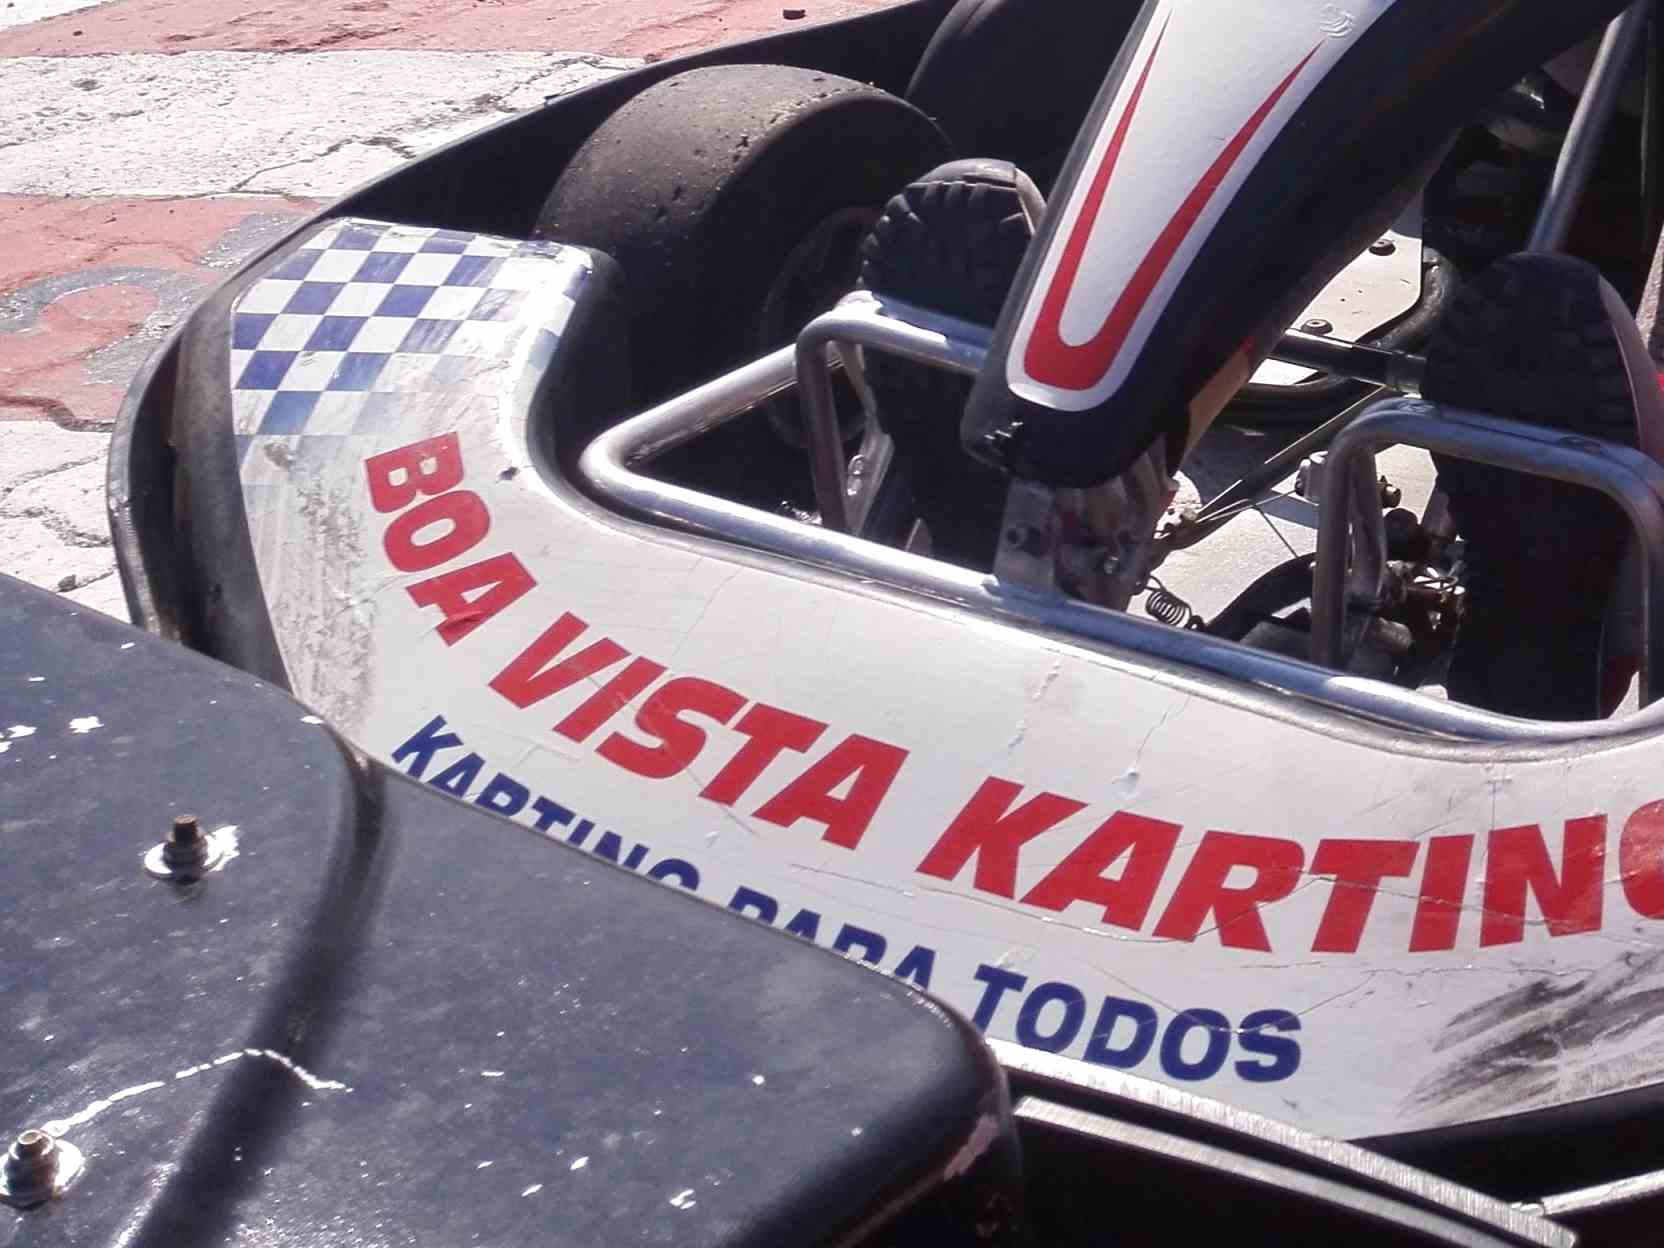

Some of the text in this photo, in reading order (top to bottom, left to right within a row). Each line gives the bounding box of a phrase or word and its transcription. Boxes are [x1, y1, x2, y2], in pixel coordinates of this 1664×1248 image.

[364, 430, 538, 647] BOA
[488, 611, 910, 850] VISTA
[971, 963, 1303, 1083] TODOS
